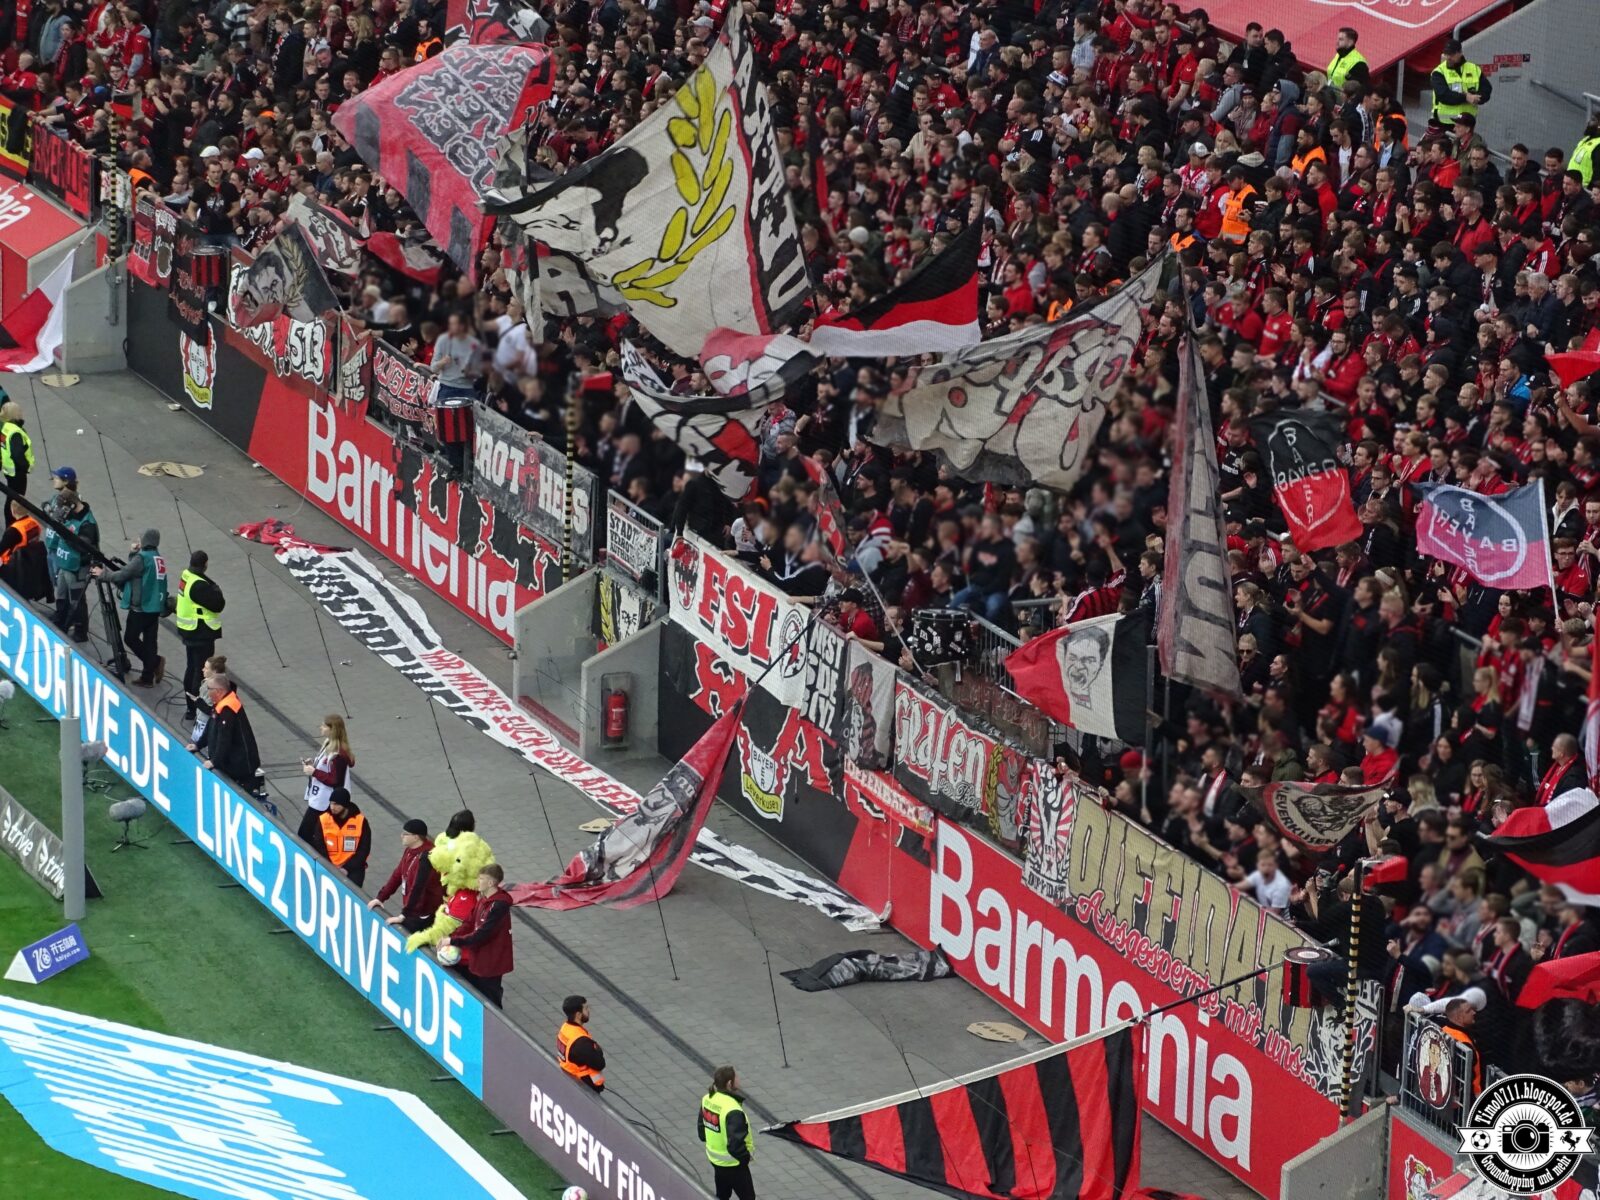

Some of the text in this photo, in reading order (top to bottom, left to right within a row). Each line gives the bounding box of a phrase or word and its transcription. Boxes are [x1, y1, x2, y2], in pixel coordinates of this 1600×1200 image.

[289, 319, 326, 385] 513
[1277, 459, 1338, 492] BAYER
[419, 649, 465, 671] IHR
[532, 747, 593, 776] ZUM
[745, 779, 780, 814] Leverkusen
[195, 764, 464, 1076] LIKE2DRIVE.DE
[529, 1082, 613, 1189] RESPEKT
